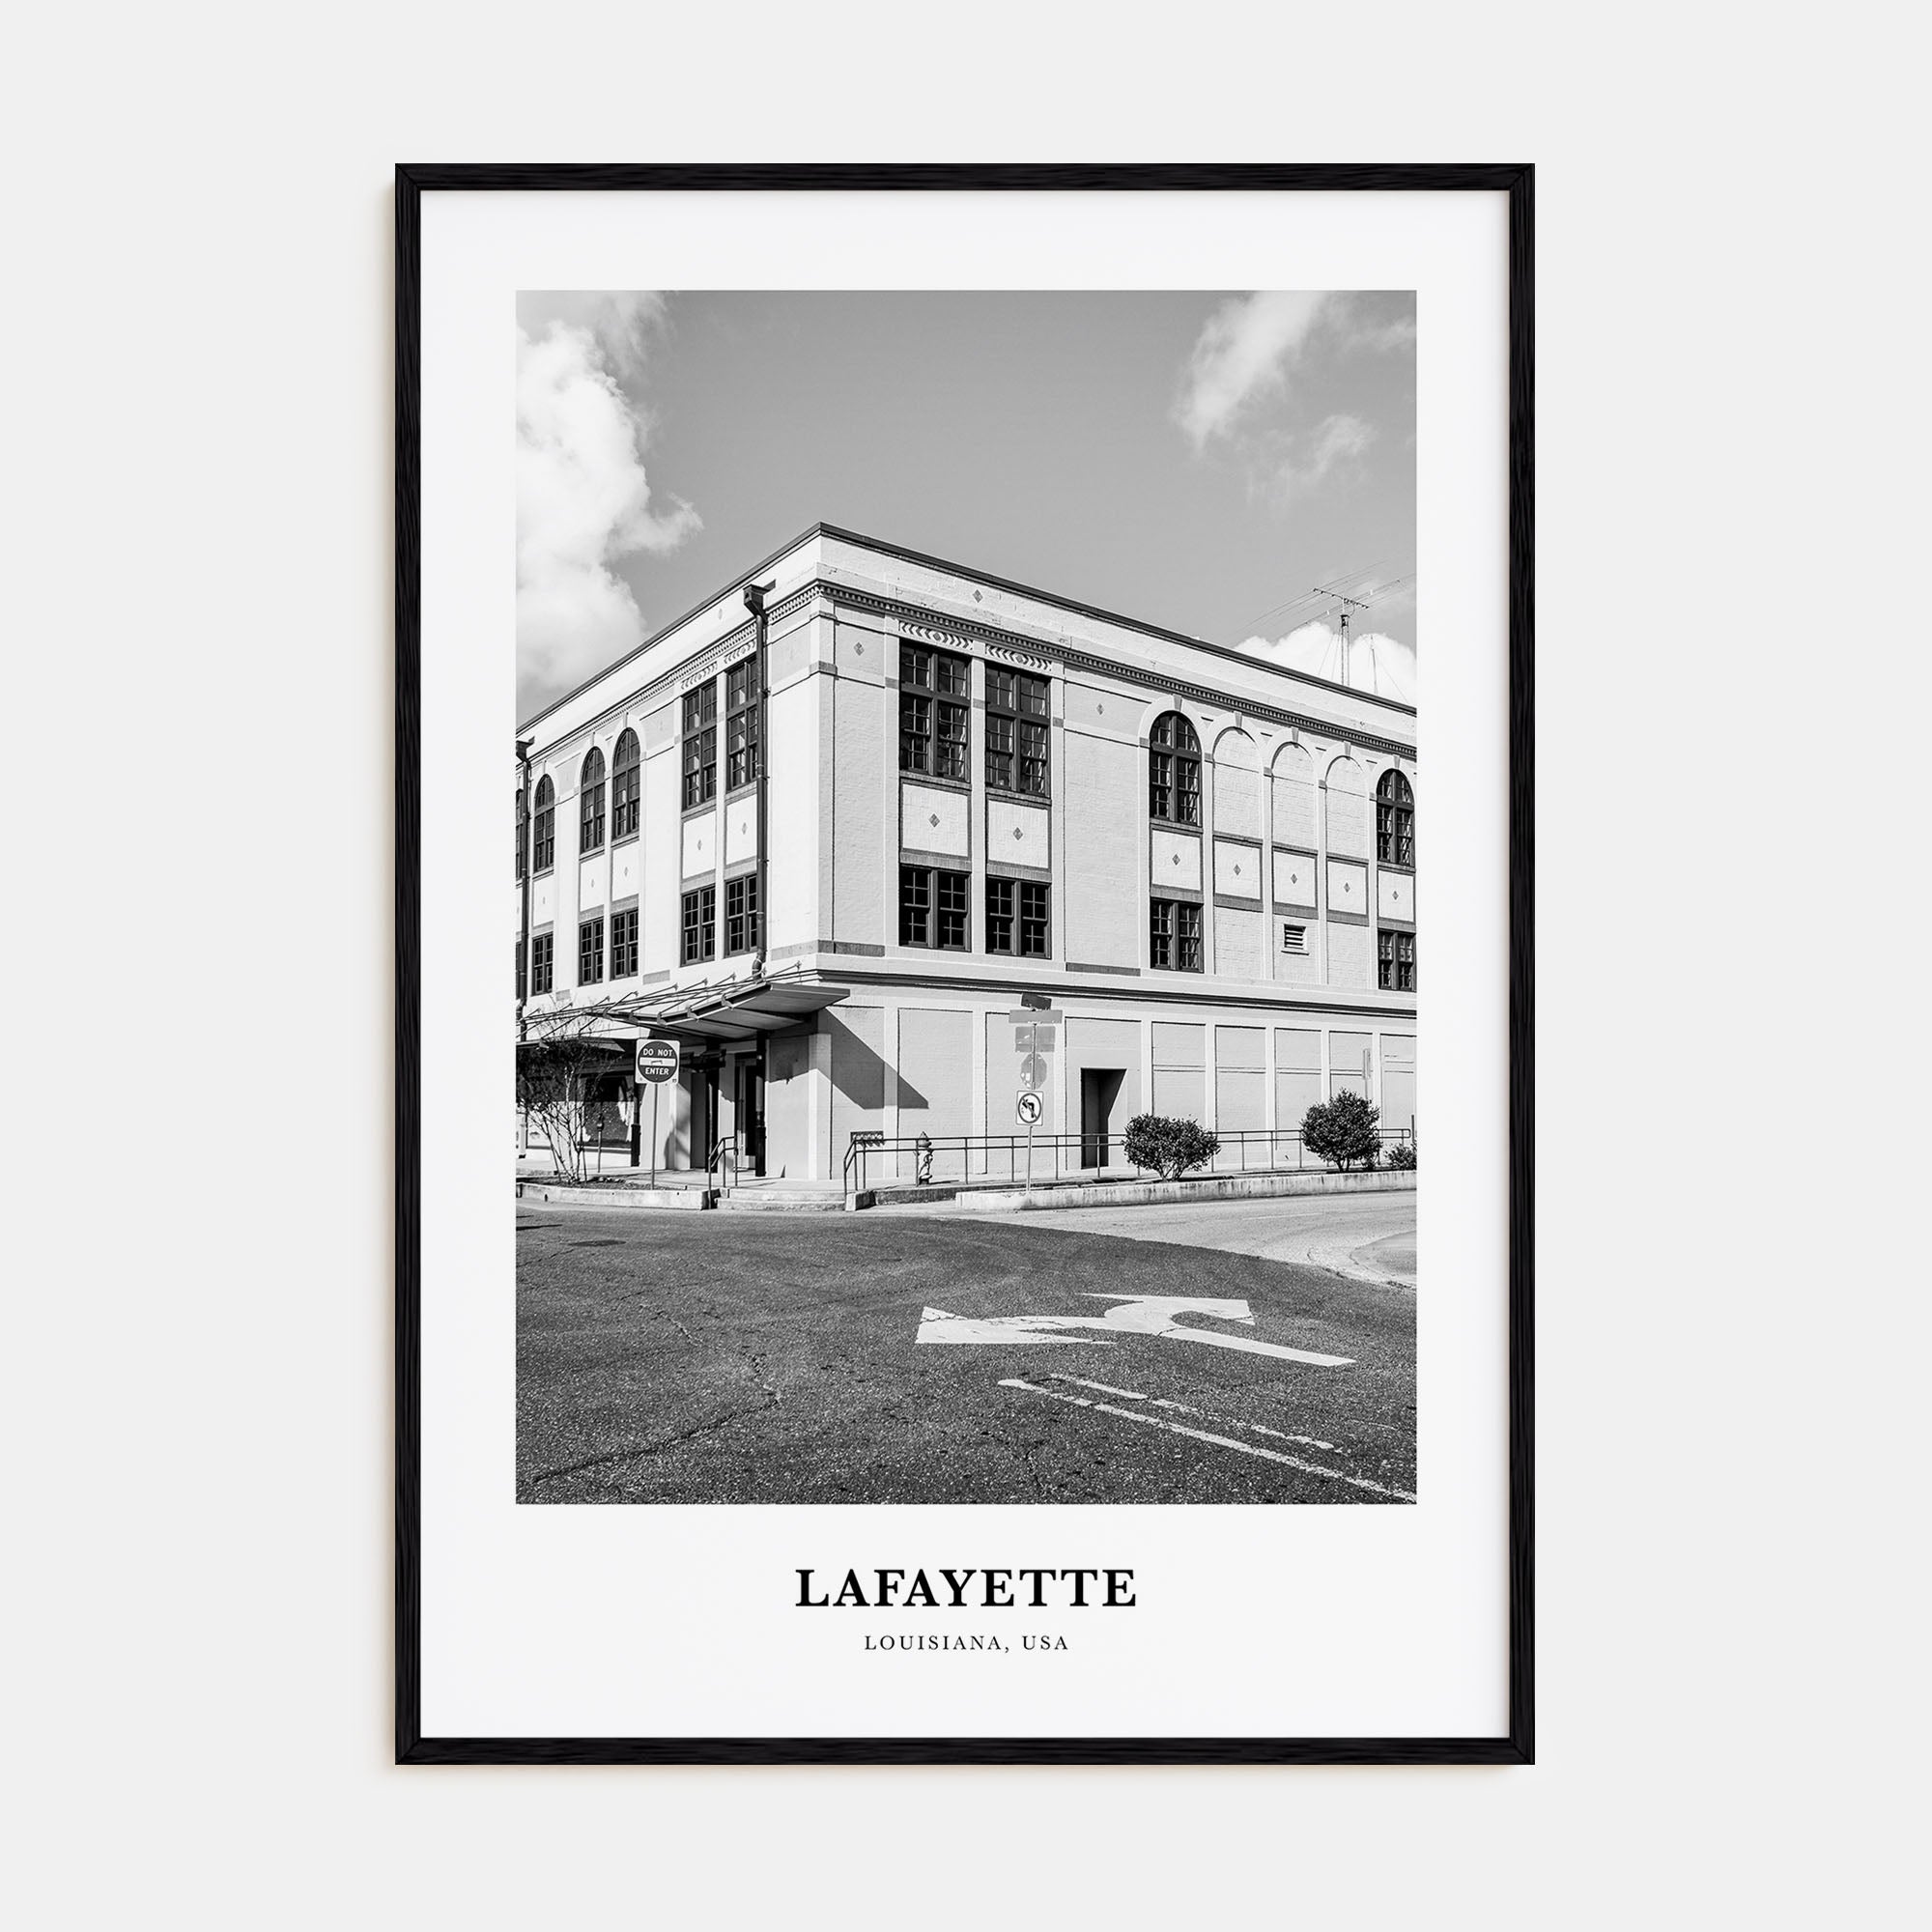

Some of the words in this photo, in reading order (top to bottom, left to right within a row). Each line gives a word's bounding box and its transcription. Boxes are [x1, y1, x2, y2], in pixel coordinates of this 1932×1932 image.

[795, 1568, 1136, 1607] LAFAYETTE
[865, 1634, 1009, 1653] LOUISIANA,
[1022, 1634, 1068, 1650] USA
